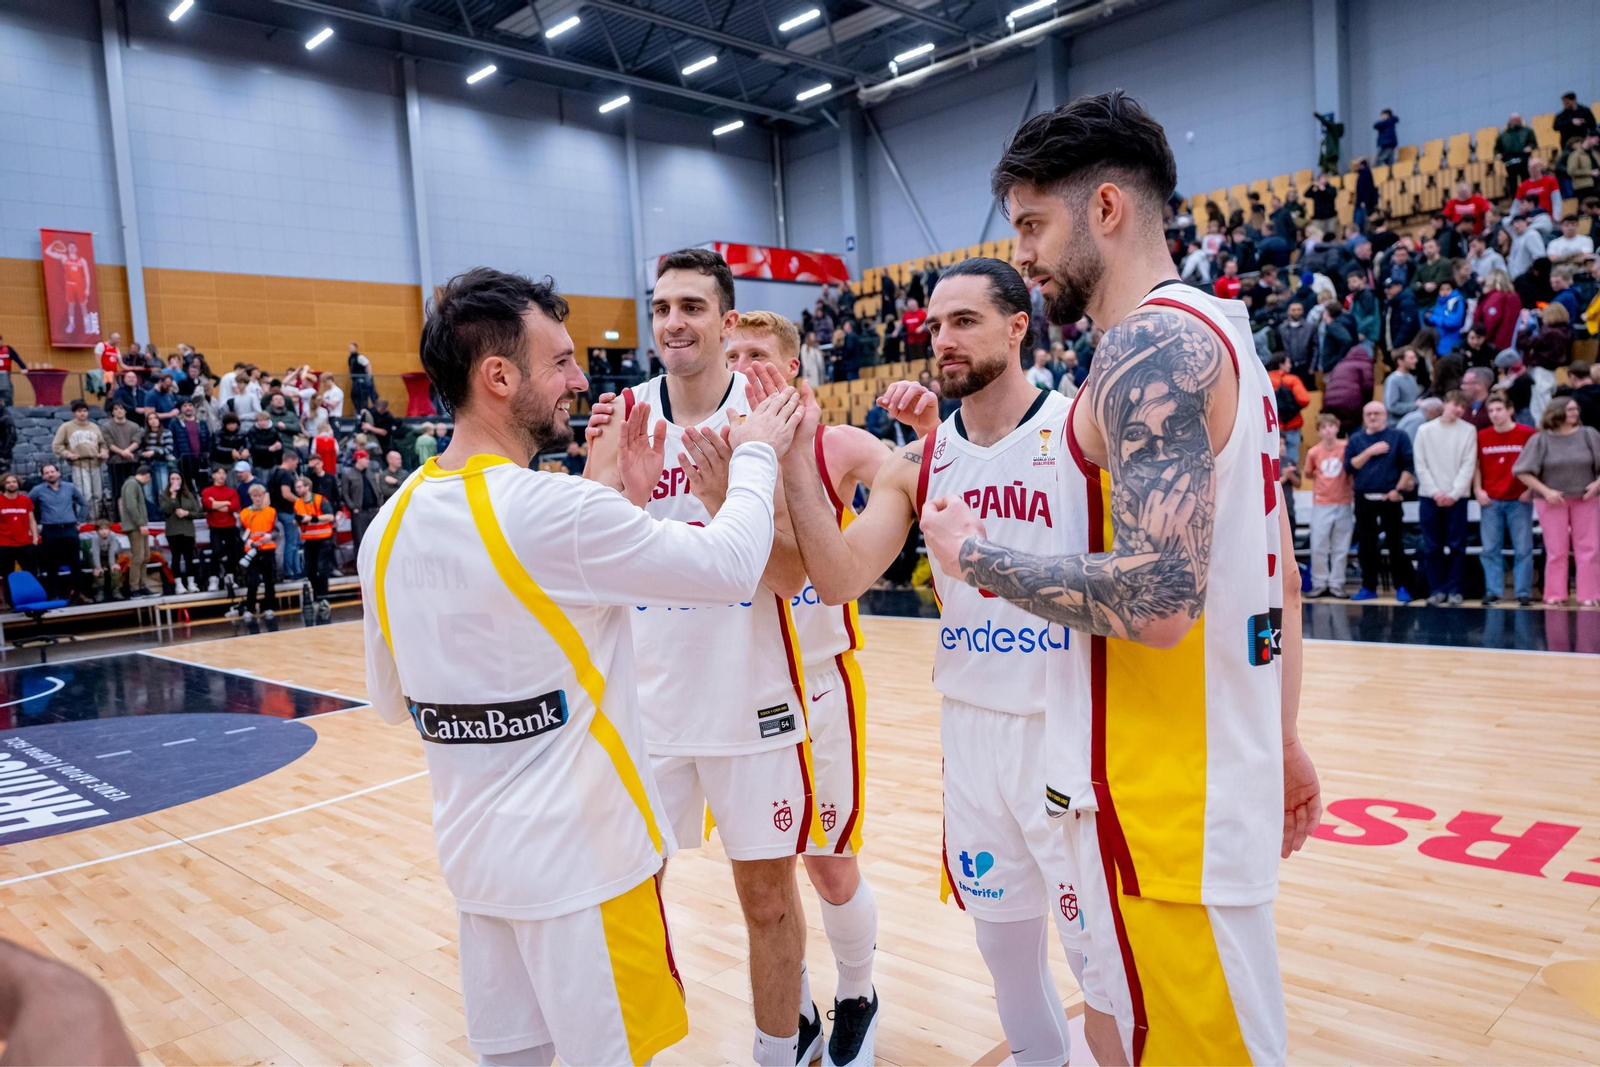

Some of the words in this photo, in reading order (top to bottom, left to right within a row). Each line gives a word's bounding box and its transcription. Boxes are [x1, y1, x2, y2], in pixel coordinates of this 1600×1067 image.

[963, 480, 1053, 528] PAÑA
[401, 555, 469, 590] COSTA
[941, 619, 1070, 653] endesa
[420, 700, 562, 739] CaixaBank
[86, 782, 131, 802] VENDE
